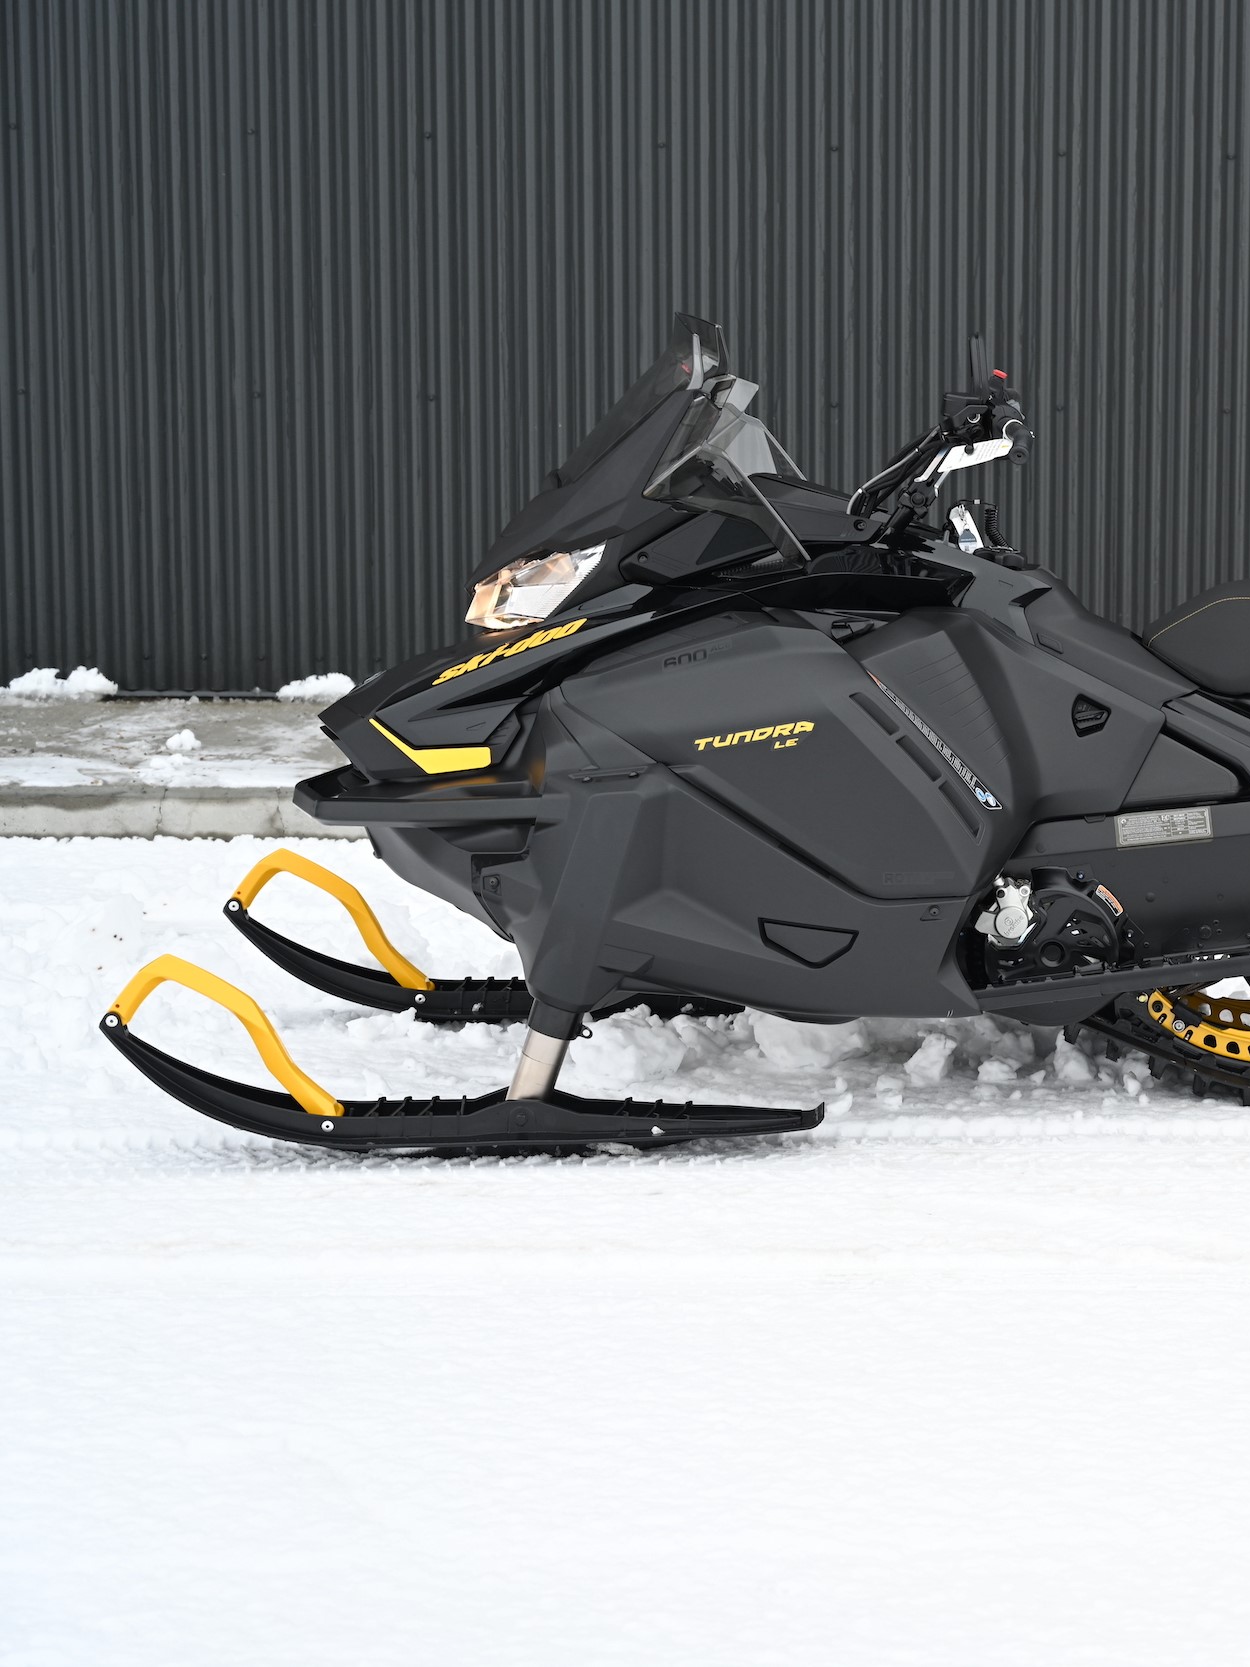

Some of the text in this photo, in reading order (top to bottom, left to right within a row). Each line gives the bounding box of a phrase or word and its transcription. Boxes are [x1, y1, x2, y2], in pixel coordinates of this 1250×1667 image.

[663, 648, 707, 668] 600
[694, 720, 815, 751] TUNDRA
[773, 738, 799, 749] LE
